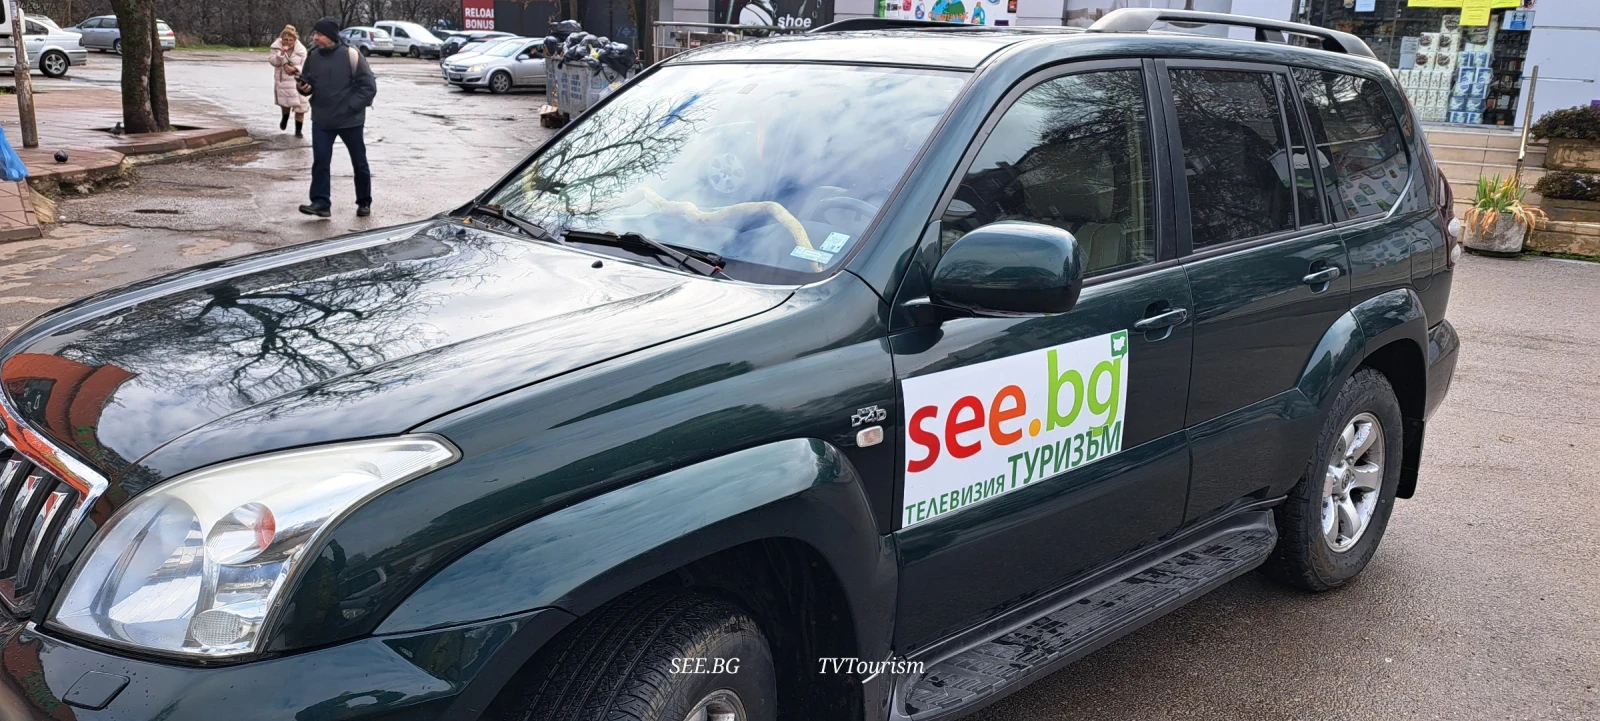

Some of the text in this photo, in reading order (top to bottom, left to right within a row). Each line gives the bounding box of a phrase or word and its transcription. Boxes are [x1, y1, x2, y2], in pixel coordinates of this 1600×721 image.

[465, 19, 495, 29] BONUS
[777, 13, 812, 28] shoe
[907, 349, 1121, 473] see.bg
[905, 421, 1122, 525] ТЕЛЕВИЗИЯ ТУРИЗЪМ
